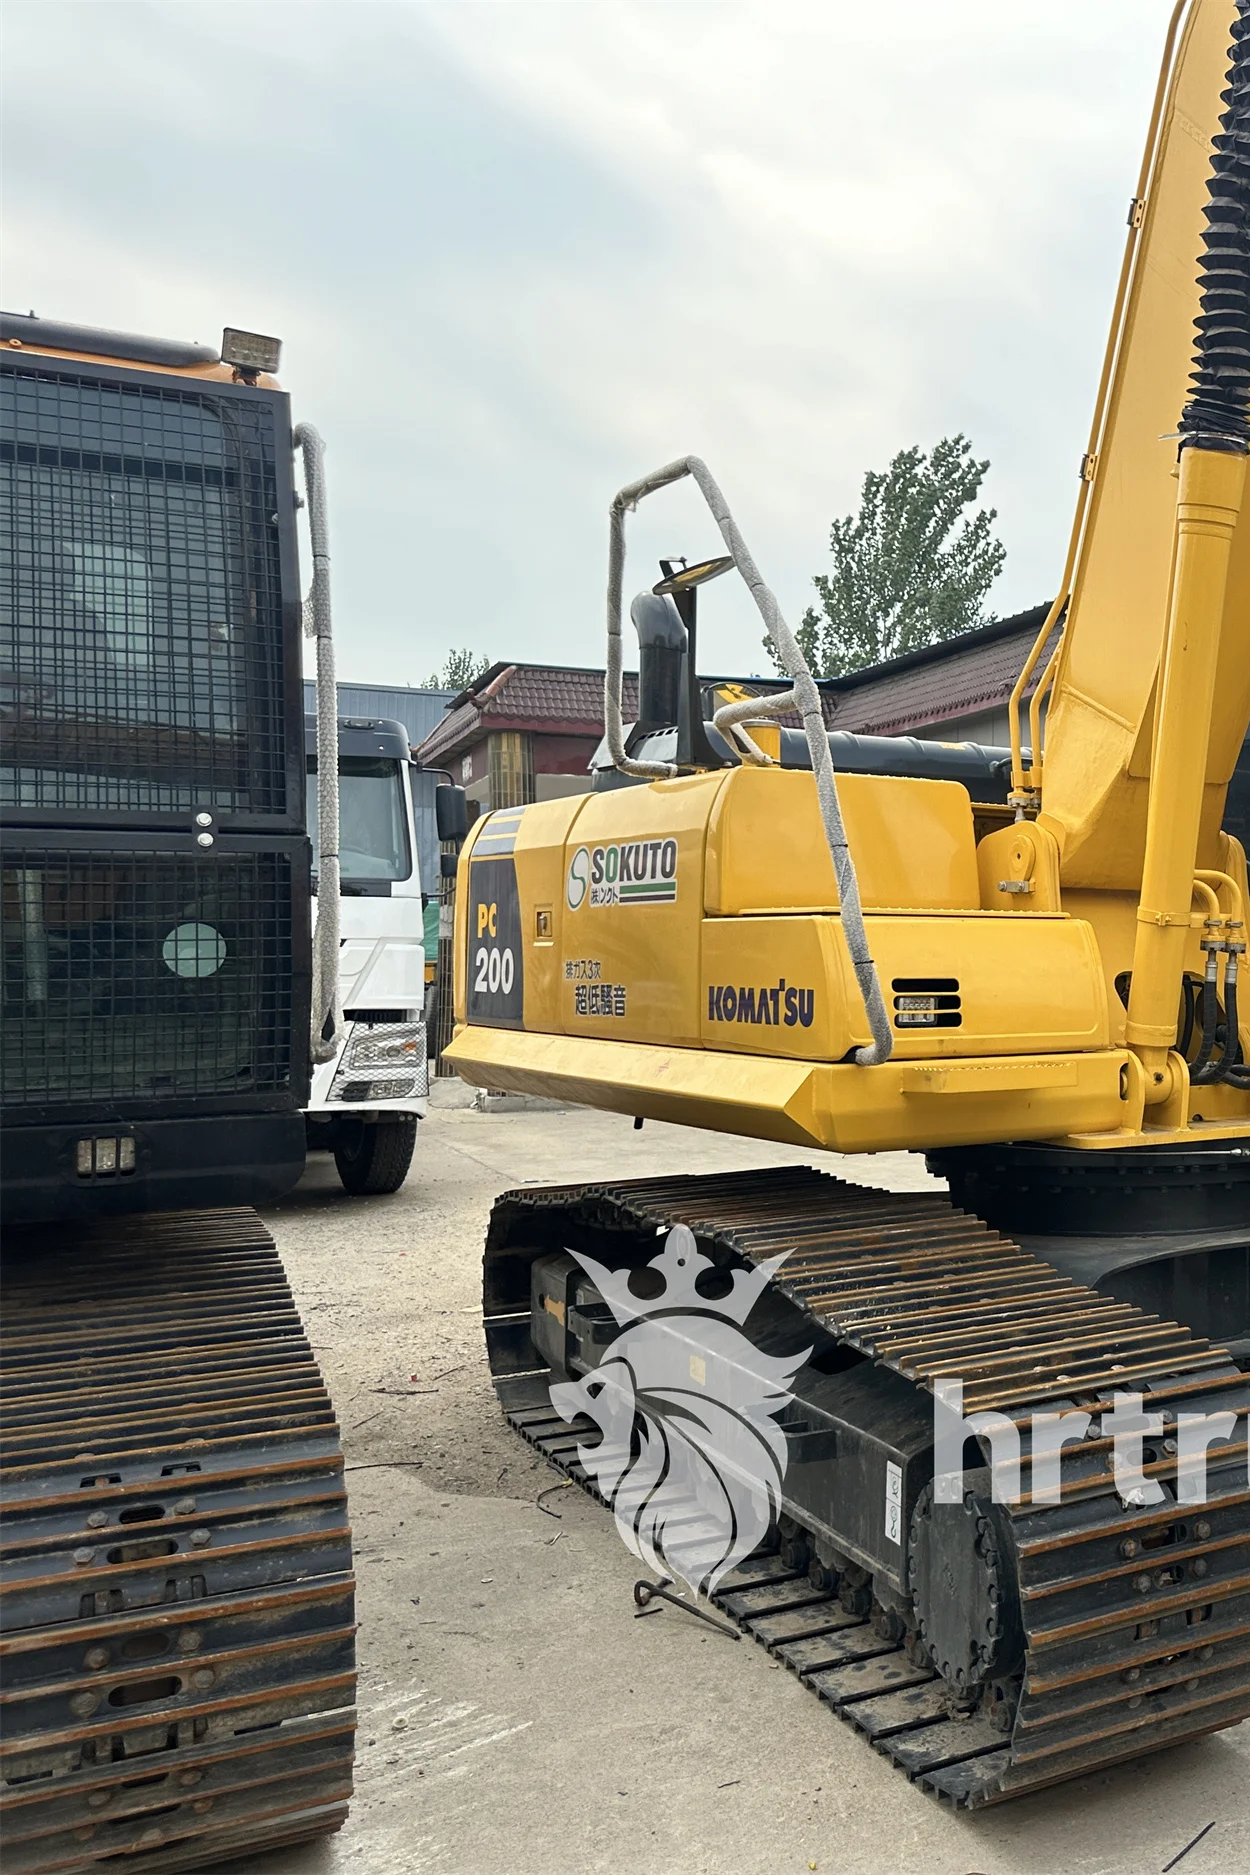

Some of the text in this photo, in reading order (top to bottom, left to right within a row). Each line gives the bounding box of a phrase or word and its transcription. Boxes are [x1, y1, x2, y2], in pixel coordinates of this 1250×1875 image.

[591, 840, 677, 884] SOKUTO
[477, 902, 497, 938] PC
[474, 947, 515, 995] 200
[708, 978, 815, 1028] KOMATSU
